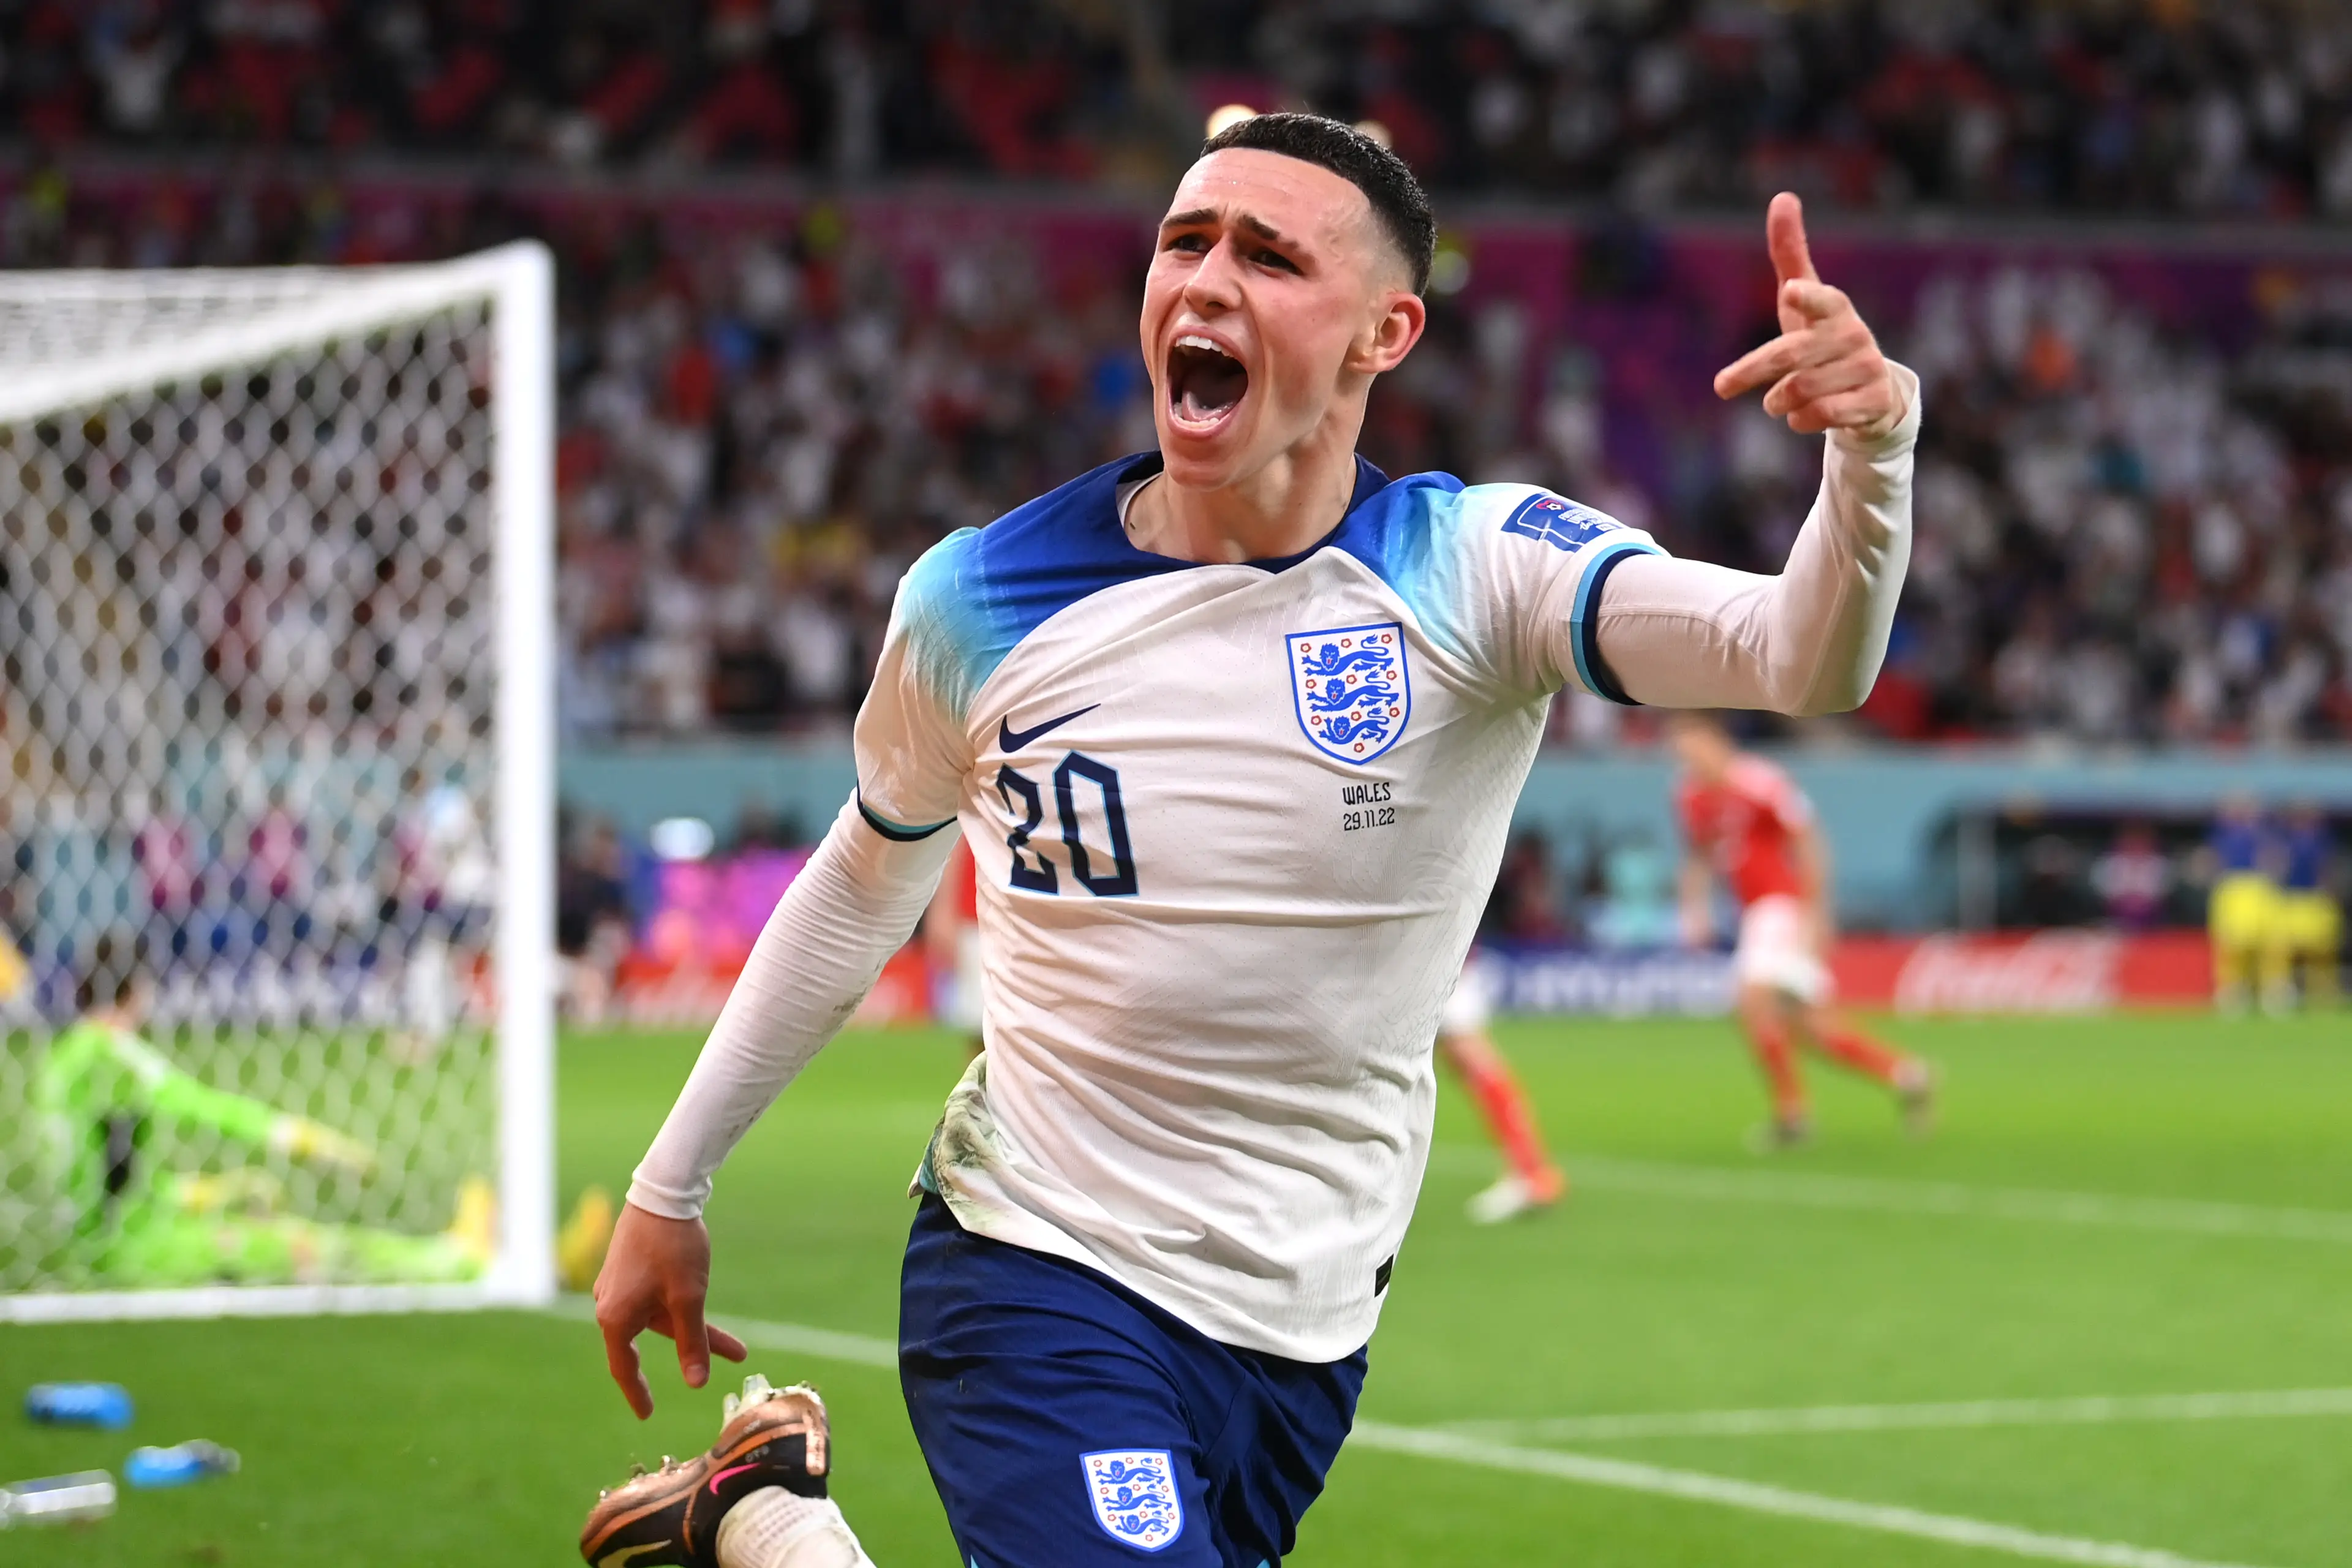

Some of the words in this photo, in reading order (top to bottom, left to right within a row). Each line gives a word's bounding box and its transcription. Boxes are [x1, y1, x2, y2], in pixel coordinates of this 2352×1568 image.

[1342, 782, 1391, 805] WALES
[995, 749, 1139, 897] 20
[1343, 807, 1395, 831] 29.11.22
